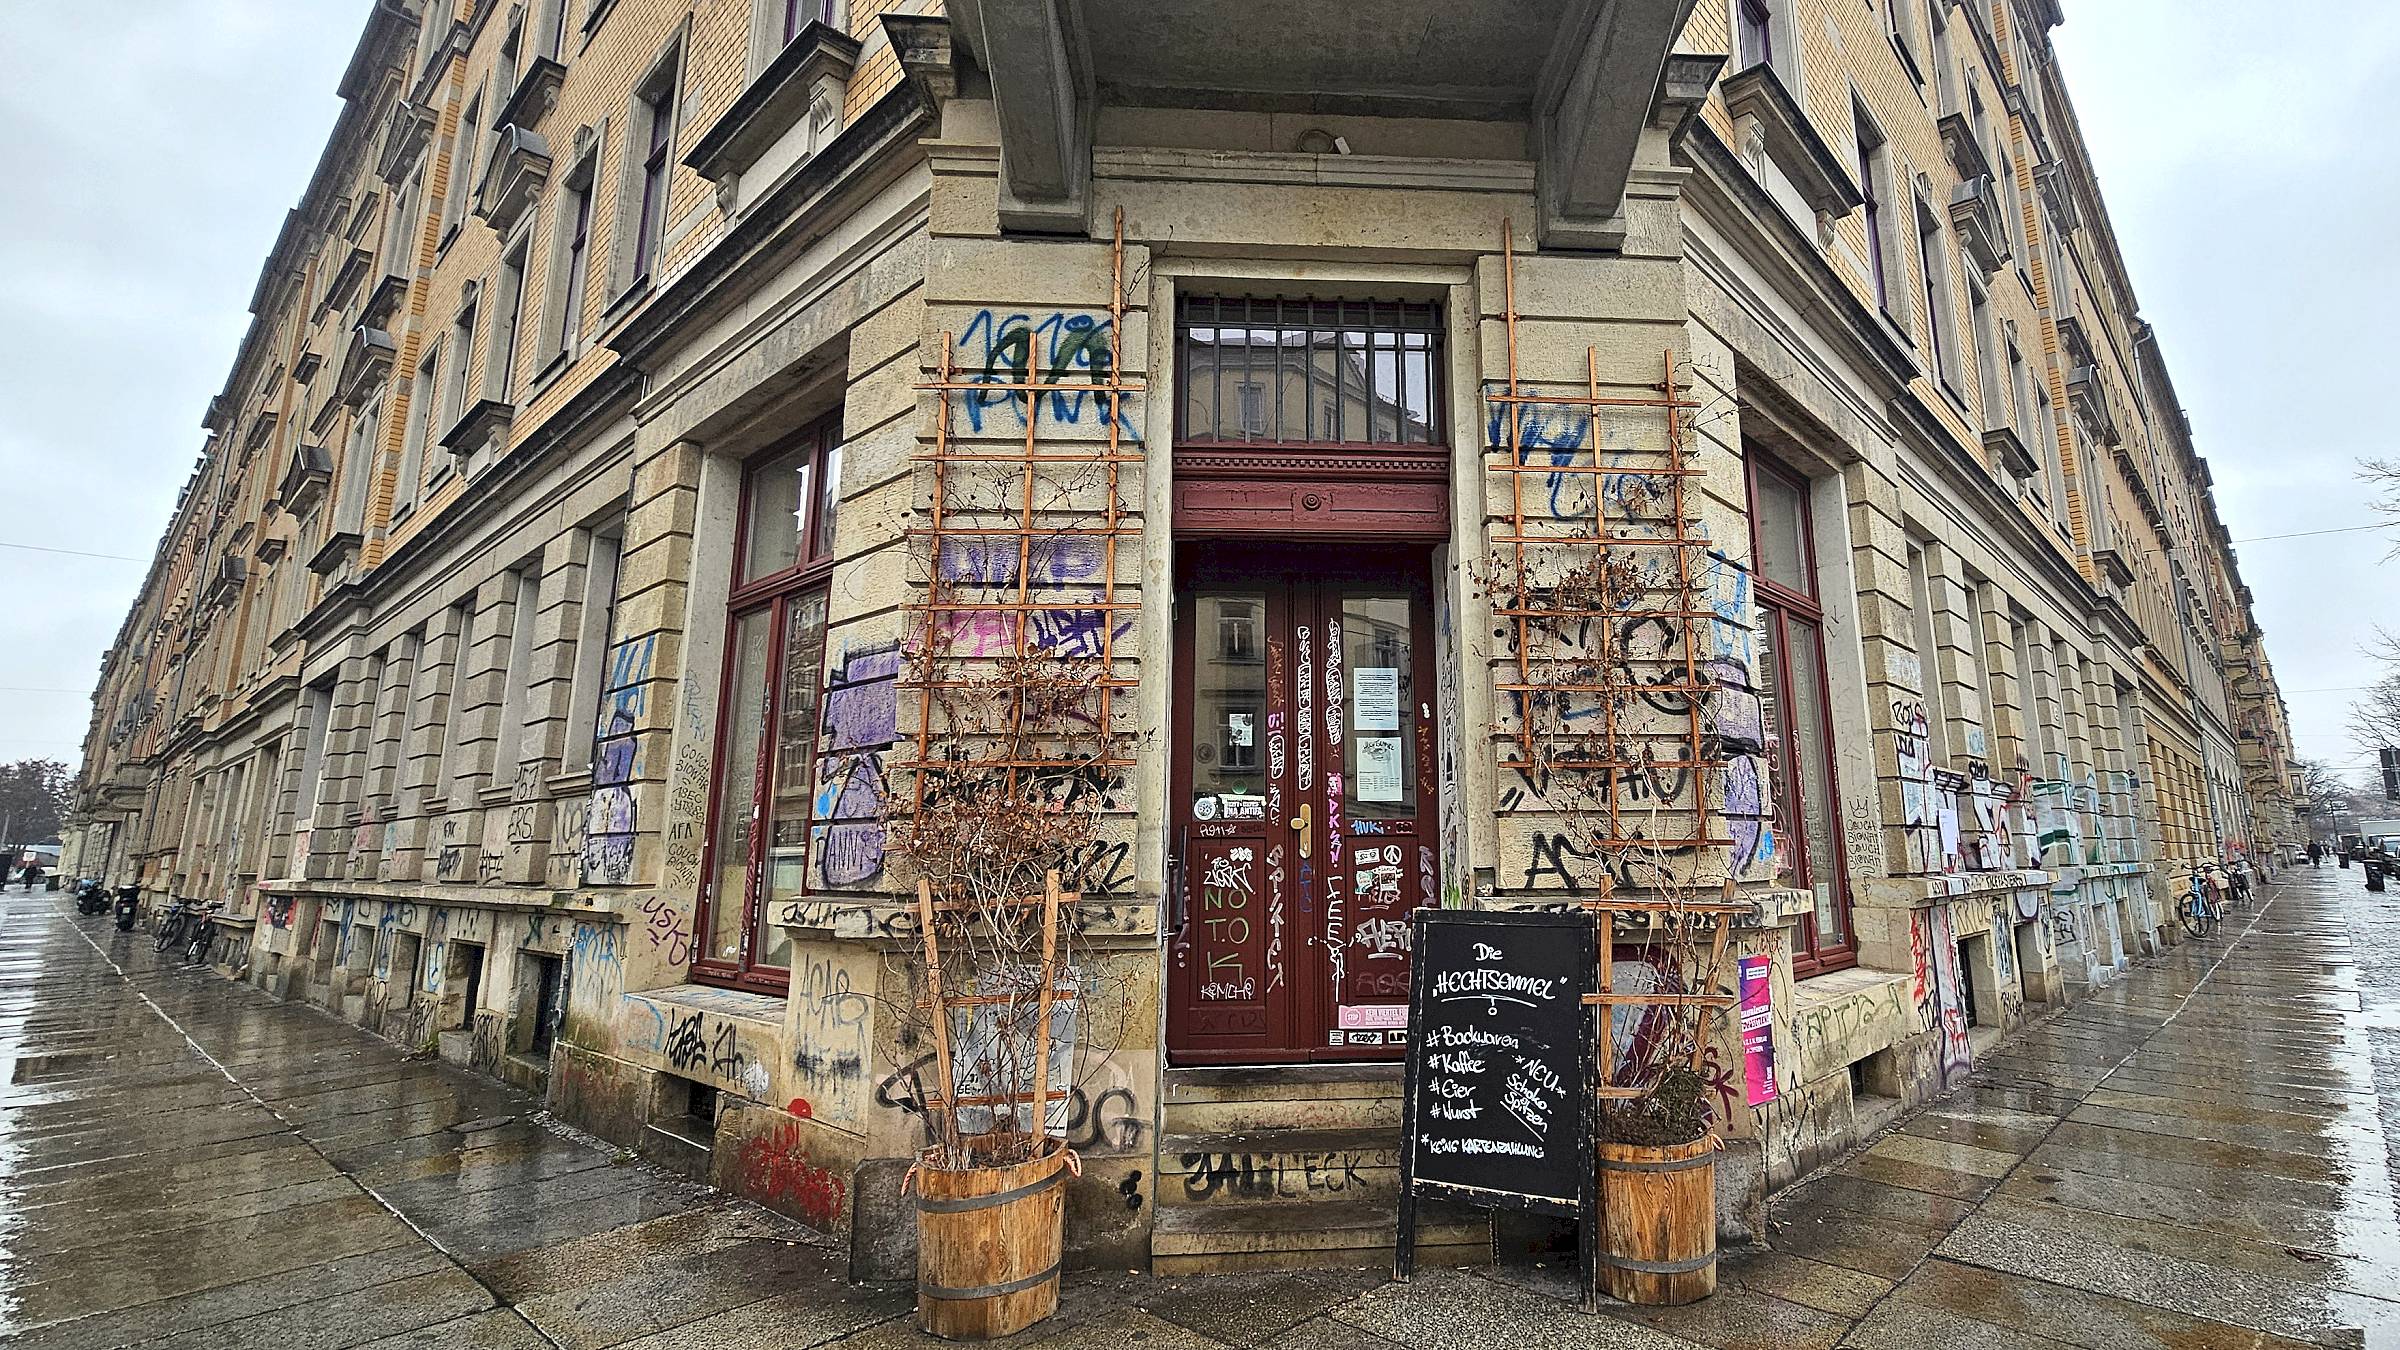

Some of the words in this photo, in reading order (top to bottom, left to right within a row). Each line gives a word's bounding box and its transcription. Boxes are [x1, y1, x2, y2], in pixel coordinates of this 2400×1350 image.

[668, 822, 693, 841] AFA
[1472, 942, 1503, 961] Die
[1426, 1025, 1519, 1050] #Backwaren
[1428, 1051, 1486, 1075] #Kaffee
[1428, 1078, 1477, 1099] #Eier
[1430, 1099, 1483, 1121] #Wurst
